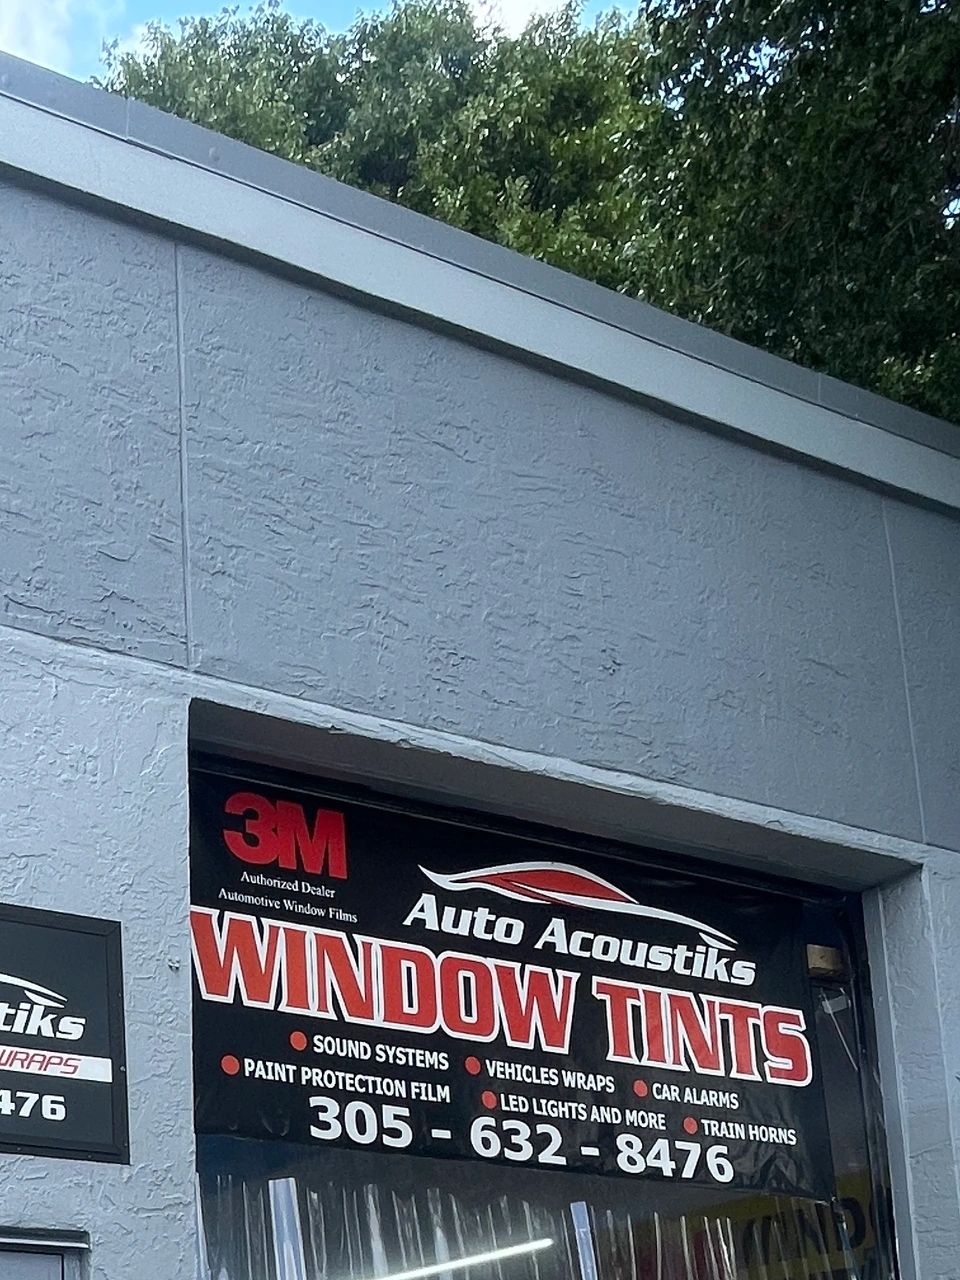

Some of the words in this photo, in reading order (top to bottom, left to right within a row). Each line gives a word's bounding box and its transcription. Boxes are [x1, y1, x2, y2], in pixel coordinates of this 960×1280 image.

[223, 792, 348, 880] 3M
[240, 871, 299, 892] Authorized
[301, 881, 336, 898] Dealer
[218, 888, 281, 909] Automotive
[283, 899, 326, 918] Window
[329, 907, 358, 923] Films
[402, 893, 524, 945] Auto
[534, 918, 757, 986] Acoustiks
[191, 905, 581, 1056] WINDOW
[592, 975, 812, 1088] TINTS
[313, 1035, 371, 1060] SOUND
[376, 1044, 449, 1070] SYSTEMS
[243, 1058, 297, 1078] PAINT
[301, 1066, 406, 1099] PROTECTION
[411, 1082, 450, 1103] FILM
[486, 1059, 558, 1085] VEHICLES
[562, 1070, 615, 1094] WRAPS
[501, 1093, 529, 1114] LED
[533, 1097, 587, 1122] LIGHTS
[590, 1104, 622, 1126] AND
[625, 1110, 666, 1131] MORE
[652, 1083, 680, 1102] CAR
[683, 1088, 739, 1110] ALARMS
[308, 1096, 413, 1149] 305
[470, 1116, 567, 1166] 632
[616, 1134, 735, 1183] 8476
[701, 1119, 745, 1140] TRAIN
[749, 1124, 797, 1146] HORNS
